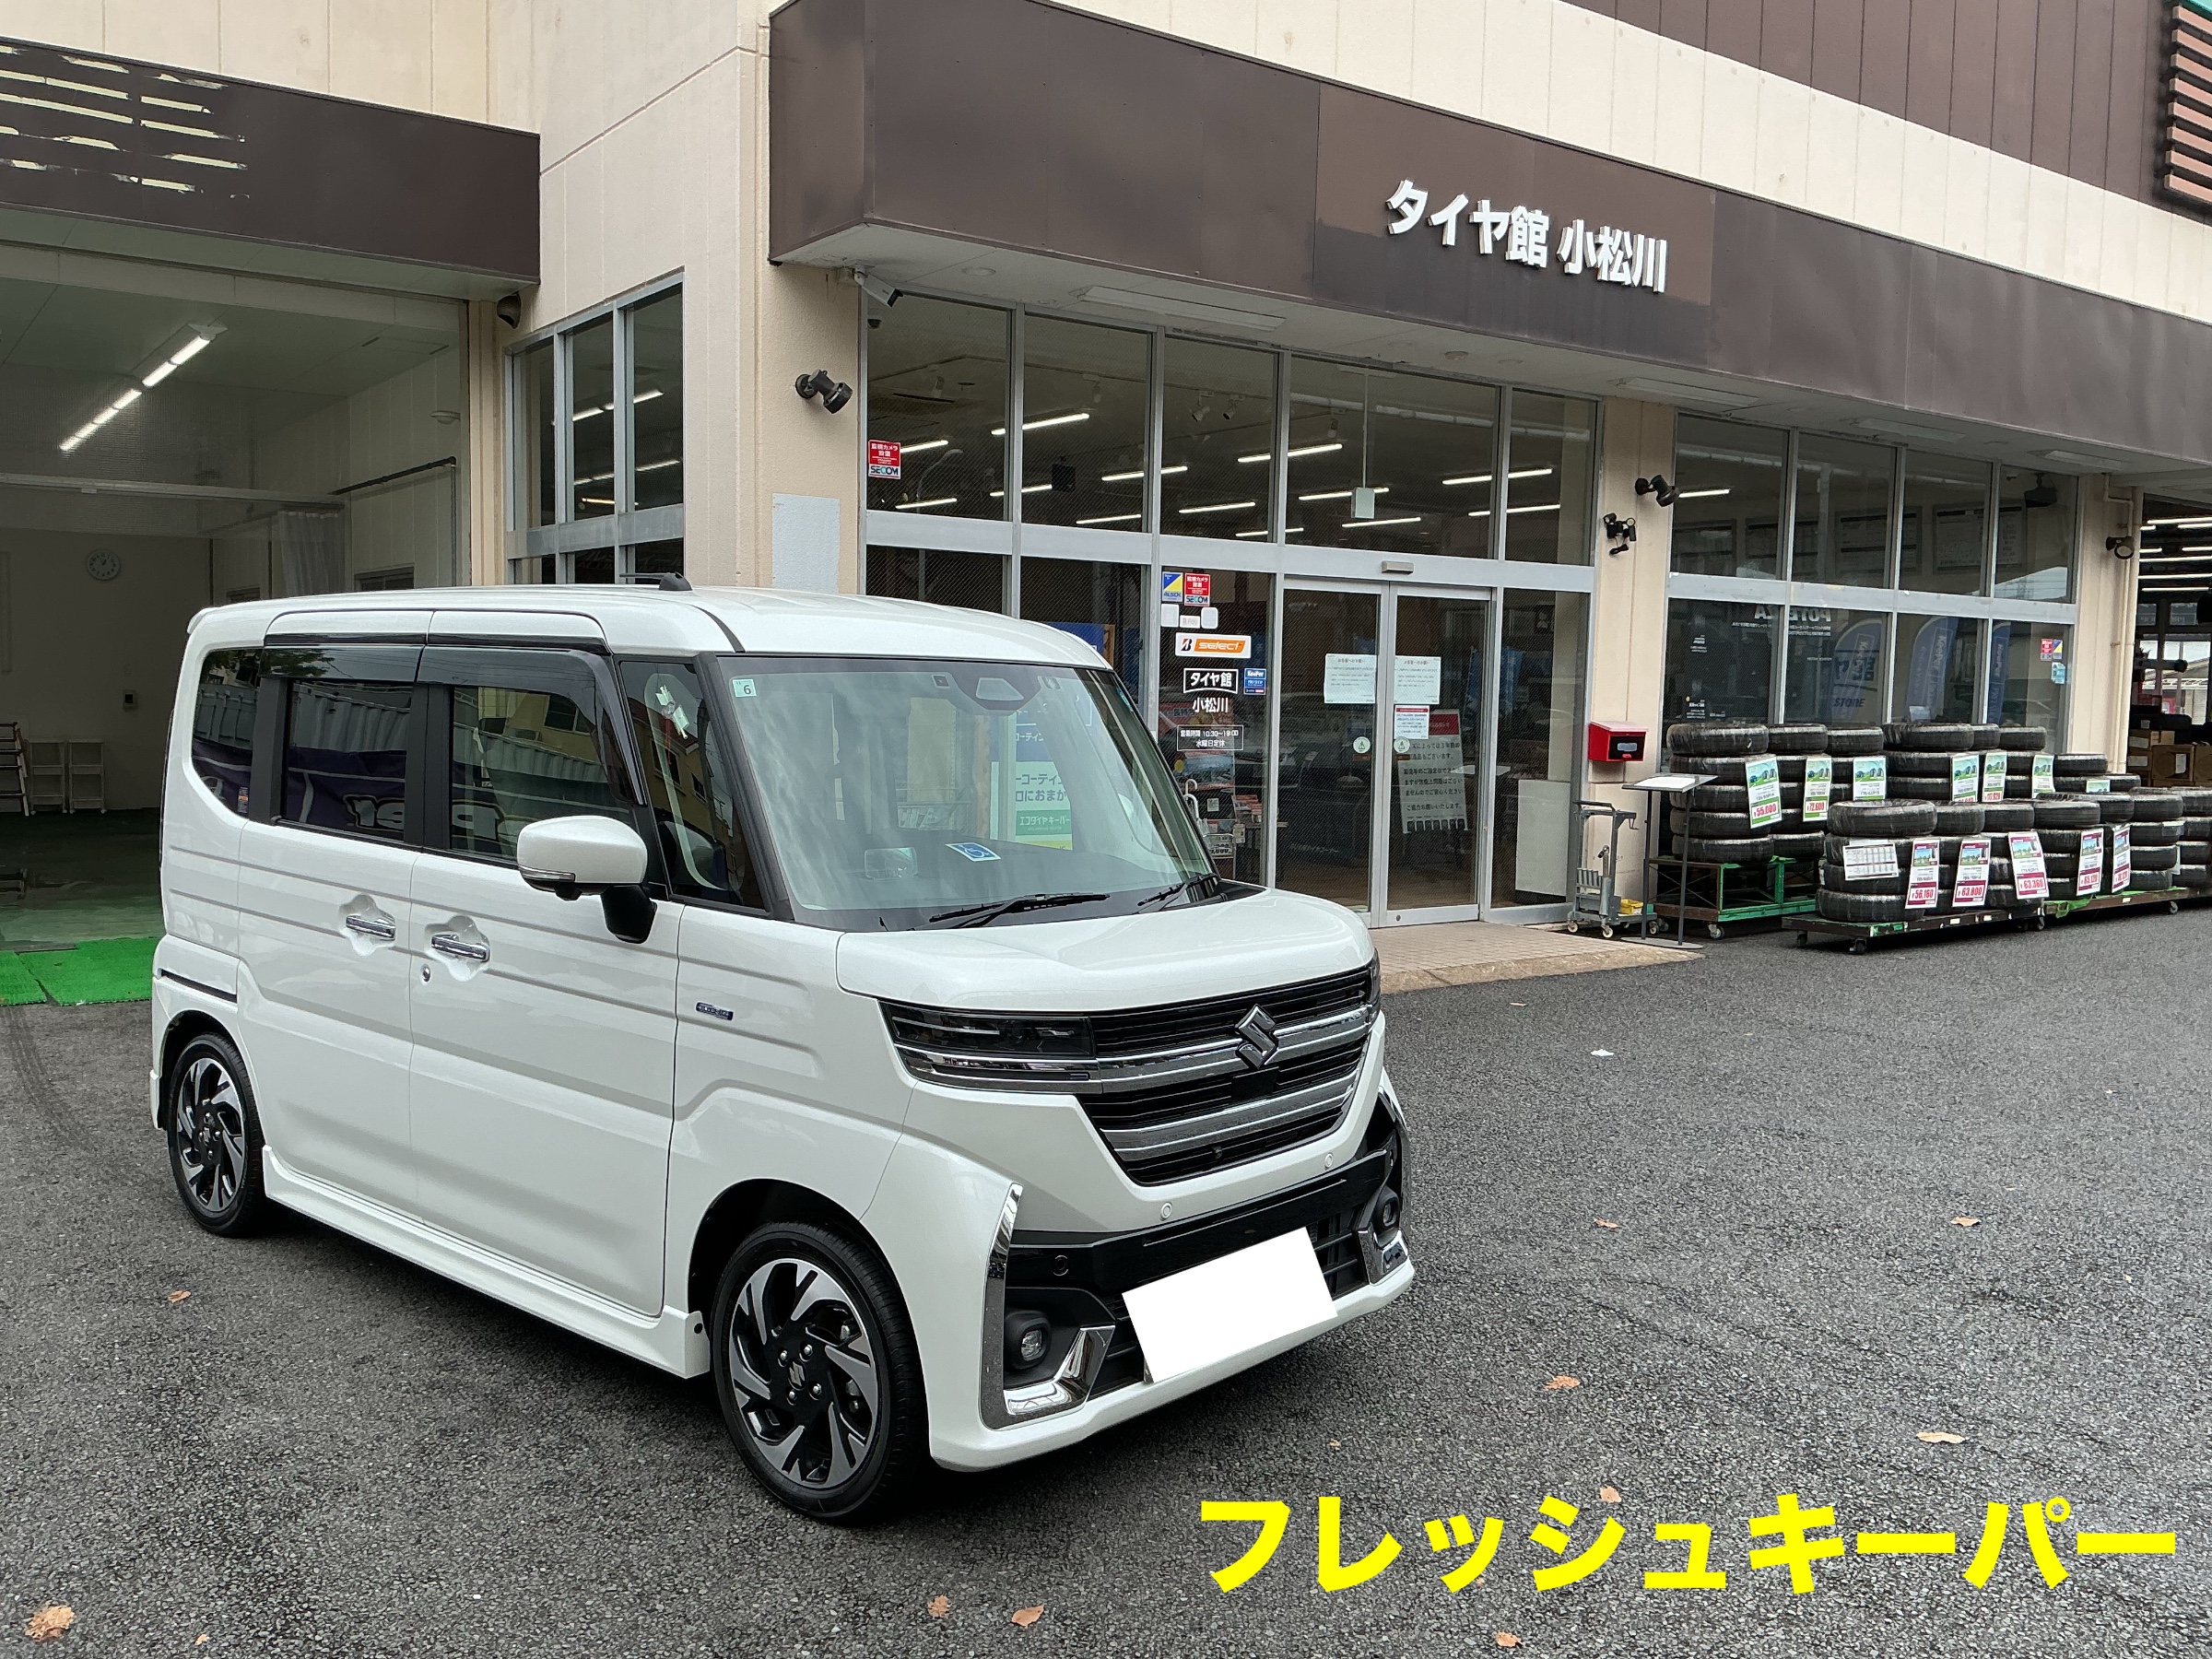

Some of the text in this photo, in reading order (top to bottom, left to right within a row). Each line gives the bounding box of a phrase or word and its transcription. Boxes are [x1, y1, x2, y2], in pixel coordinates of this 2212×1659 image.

[1386, 178, 1667, 293] タイヤ館 小松川
[870, 465, 899, 476] SECOM
[1198, 641, 1239, 651] select
[1190, 672, 1232, 688] タイヤ館
[743, 684, 752, 695] 6
[1192, 697, 1229, 713] 小松川
[1195, 739, 1226, 747] 水曜日定休
